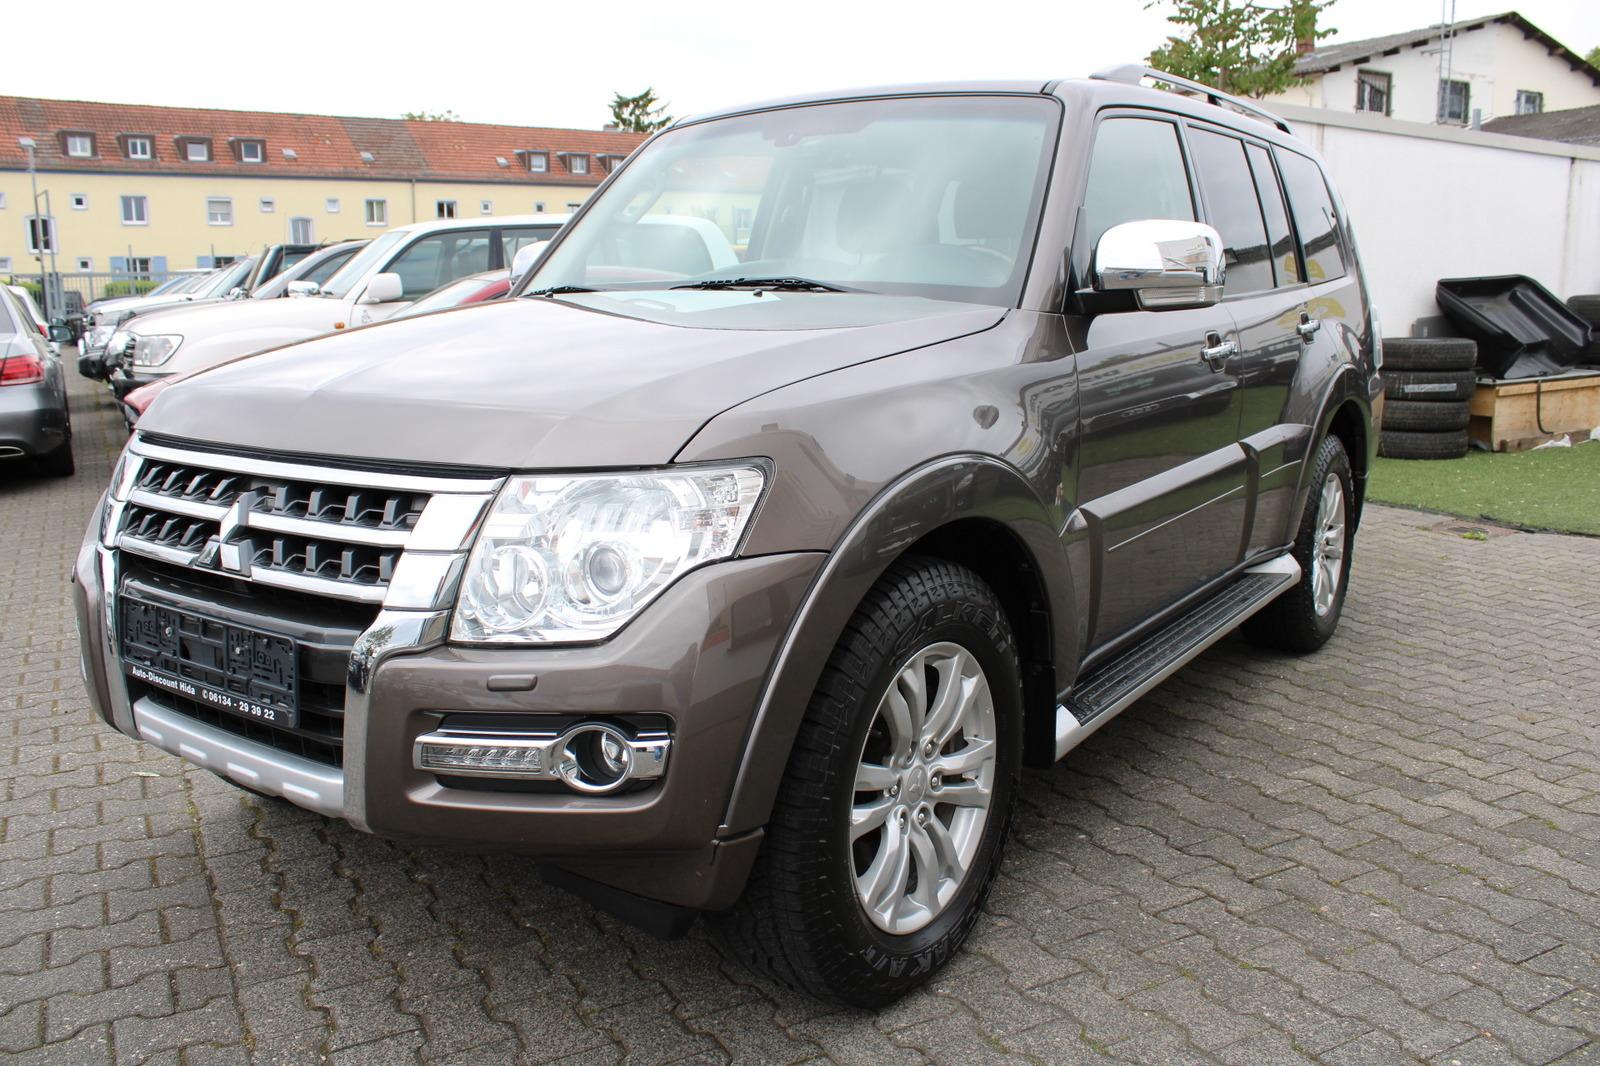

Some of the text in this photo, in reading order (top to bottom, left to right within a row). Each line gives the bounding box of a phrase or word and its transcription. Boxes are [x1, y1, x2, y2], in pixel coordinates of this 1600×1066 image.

[132, 665, 178, 689] Auto-Discount
[179, 681, 196, 695] Hida
[239, 701, 249, 712] 29
[251, 705, 262, 716] 39
[263, 709, 275, 720] 22
